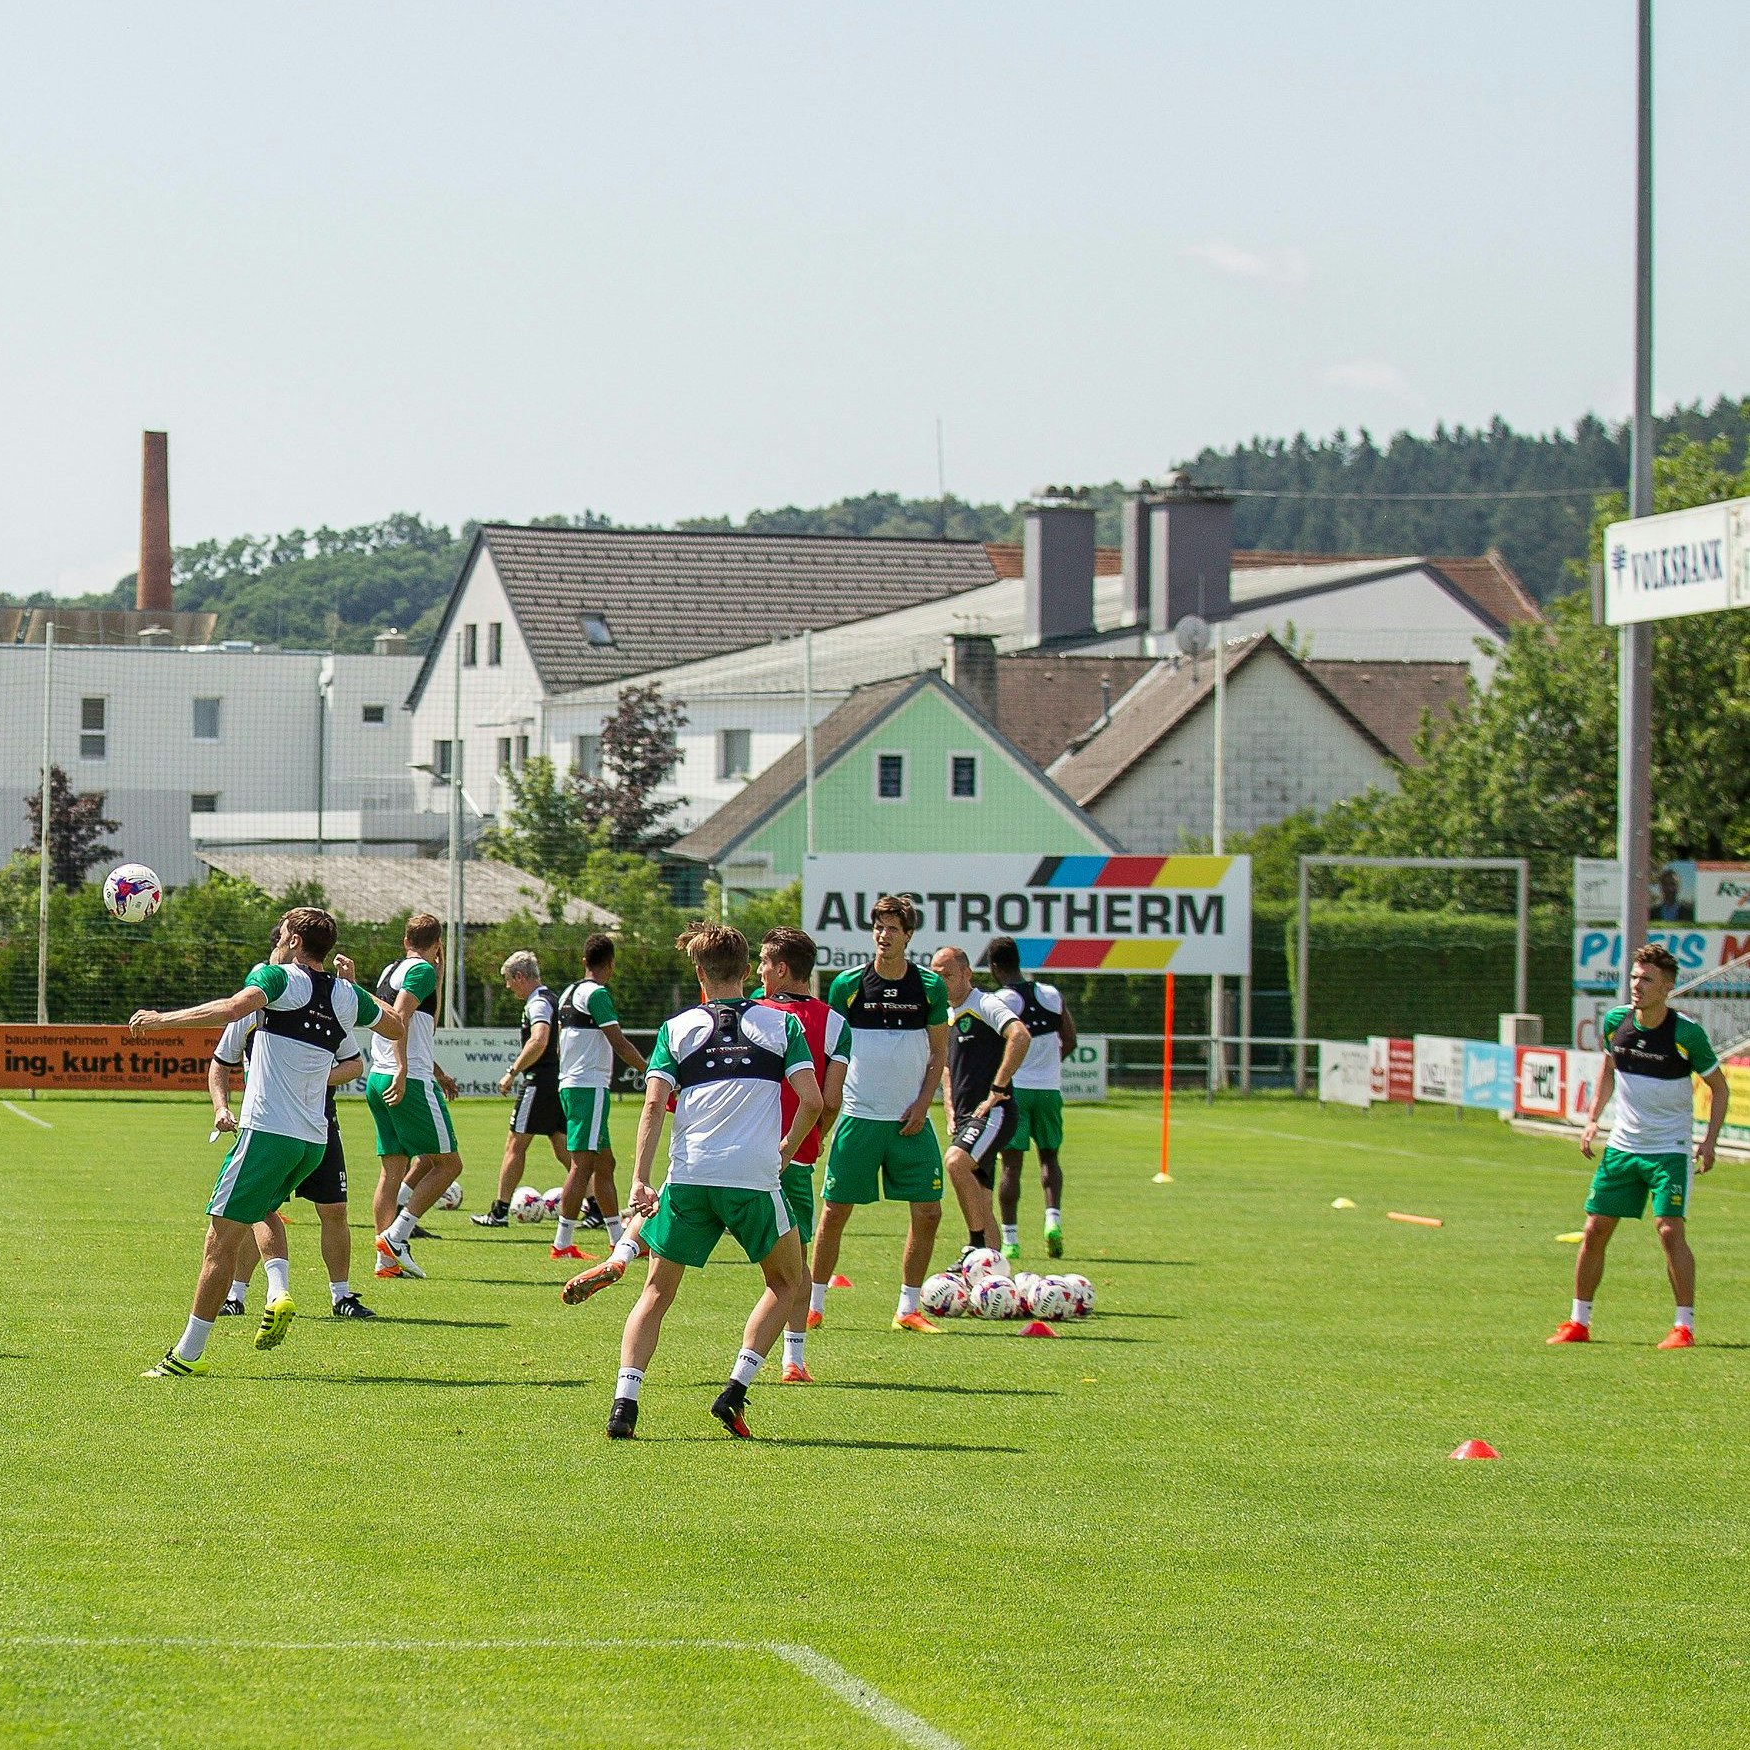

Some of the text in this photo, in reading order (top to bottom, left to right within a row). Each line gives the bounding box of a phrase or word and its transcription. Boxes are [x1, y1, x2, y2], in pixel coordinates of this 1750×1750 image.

[1631, 538, 1723, 593] VOLKSBANK
[883, 989, 898, 998] 33
[5, 1034, 184, 1047] bauunternehmen betonwerk
[4, 1050, 54, 1076] ing.
[63, 1050, 123, 1073] kurt
